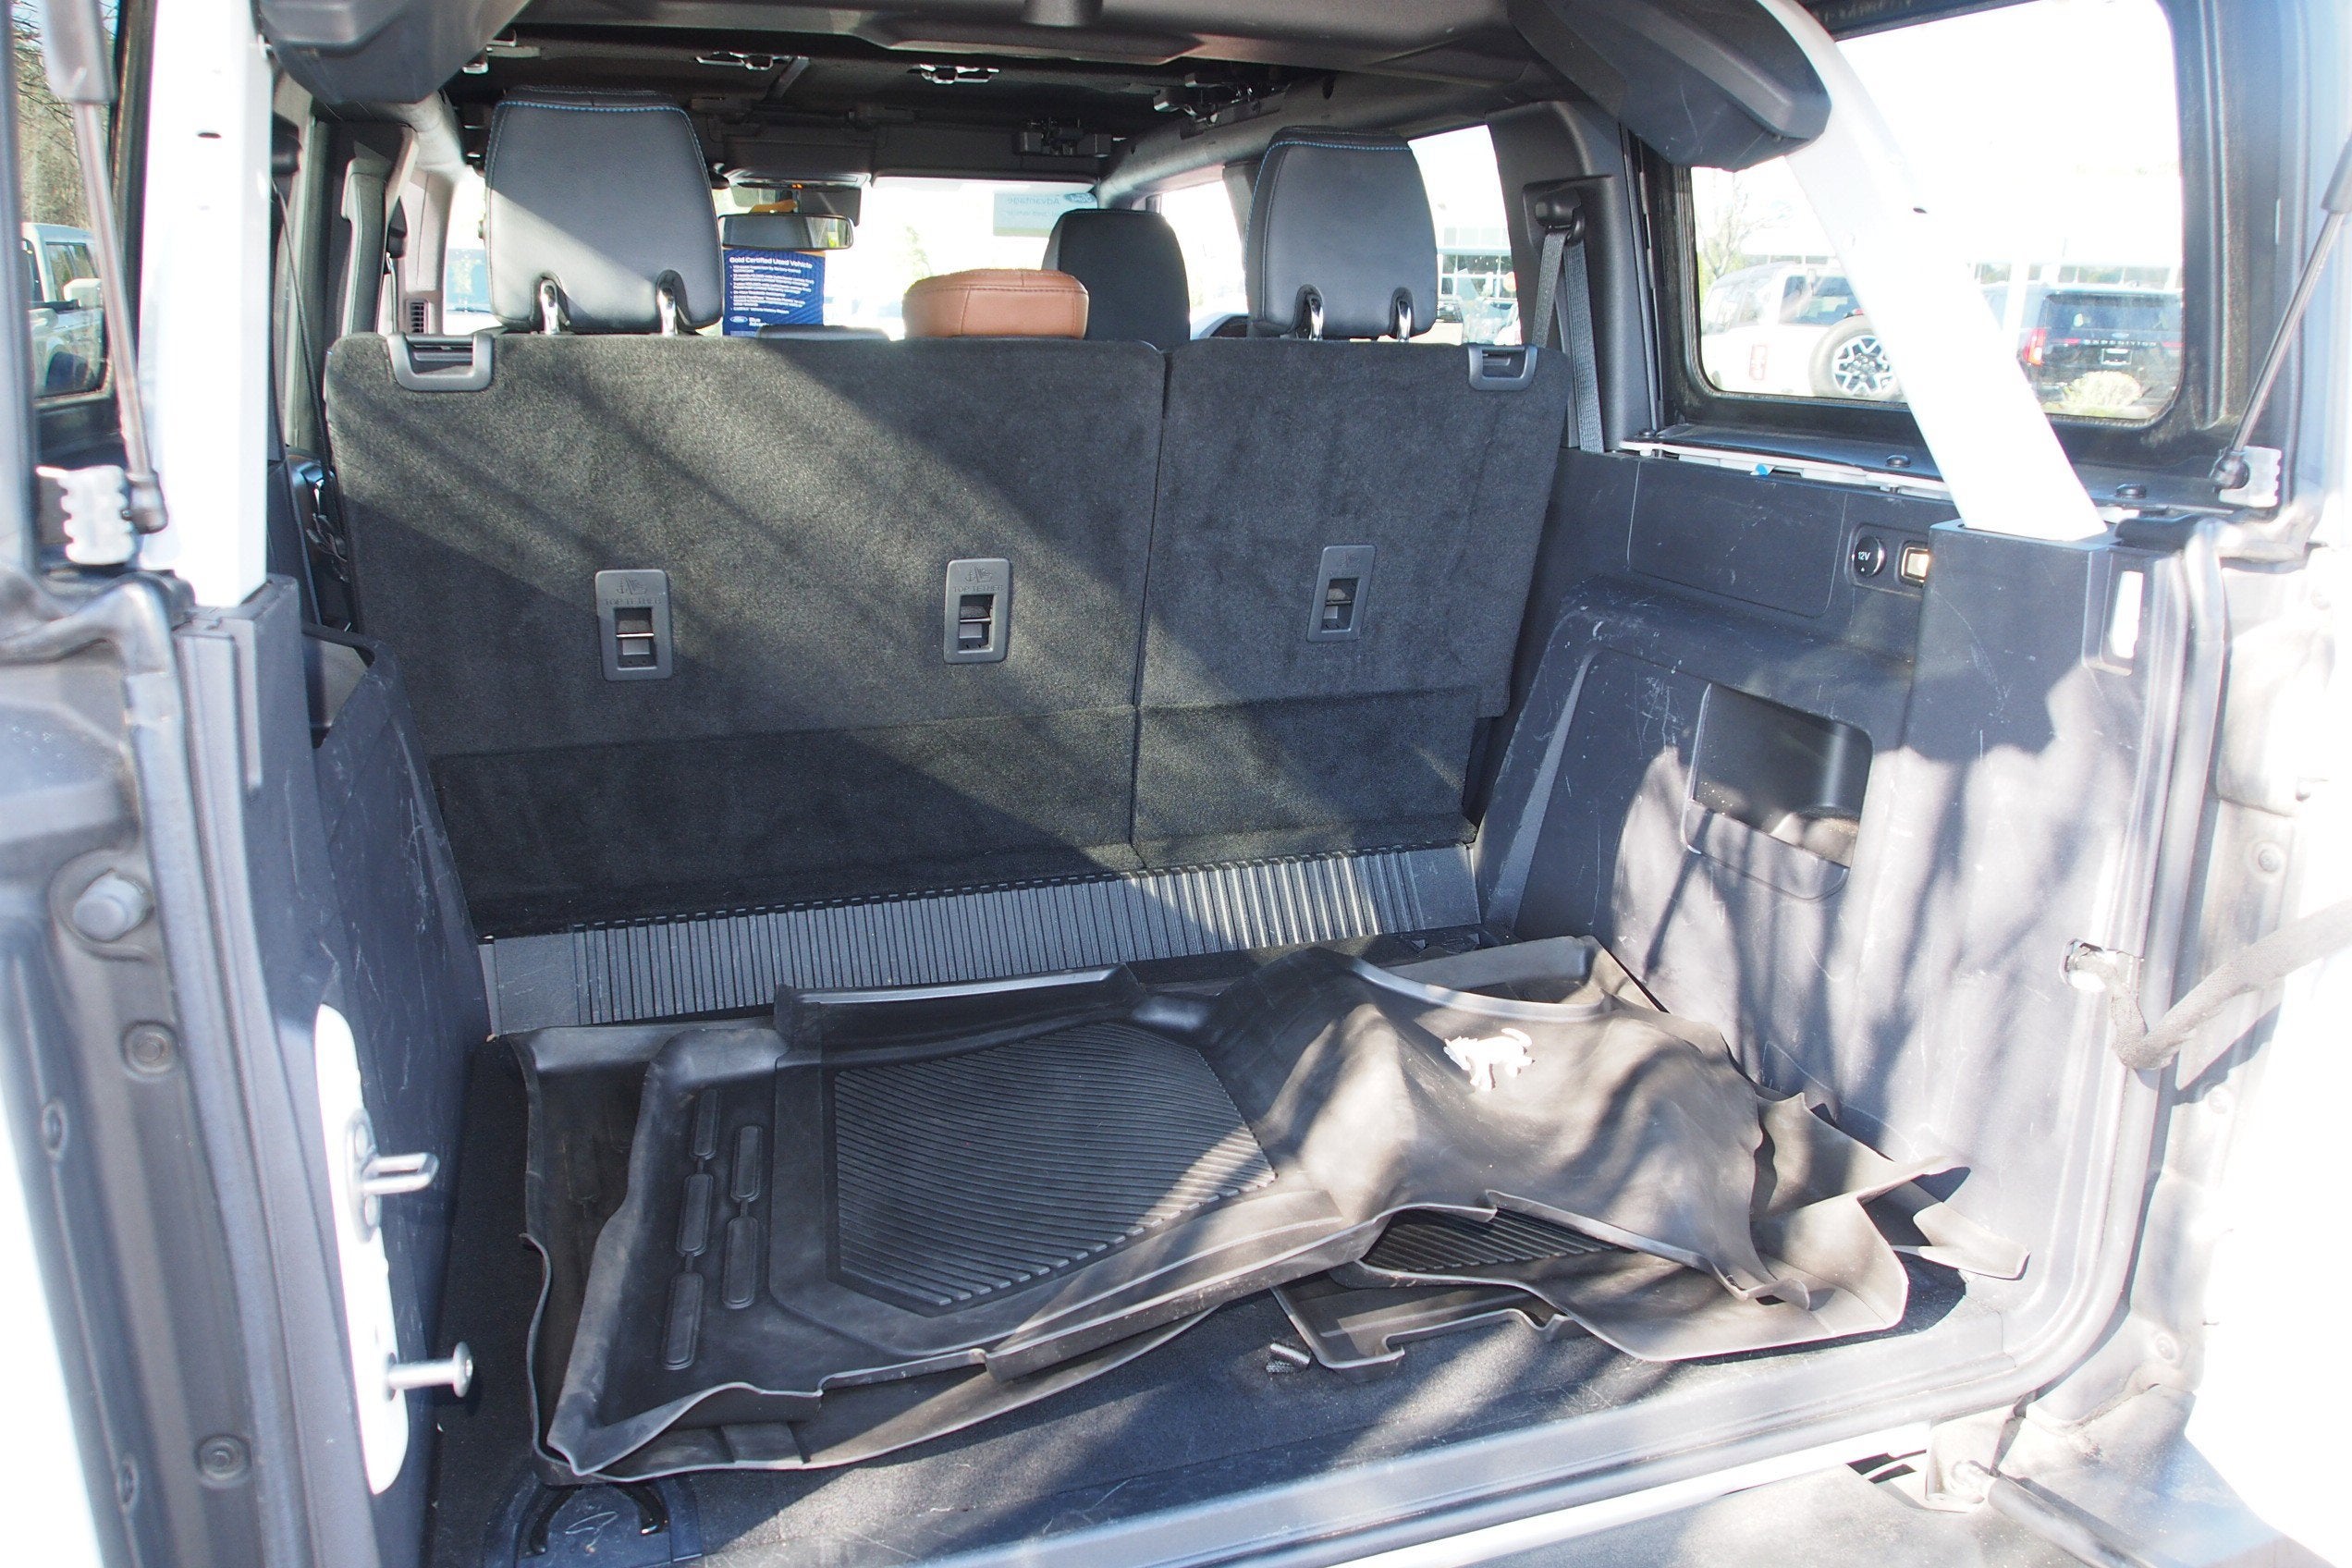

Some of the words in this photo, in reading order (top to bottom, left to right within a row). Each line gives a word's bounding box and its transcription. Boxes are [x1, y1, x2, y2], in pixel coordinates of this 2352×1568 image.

[773, 258, 790, 266] Used
[790, 260, 813, 269] Vehicle
[1857, 551, 1870, 561] 12V
[973, 584, 1004, 593] TETHER
